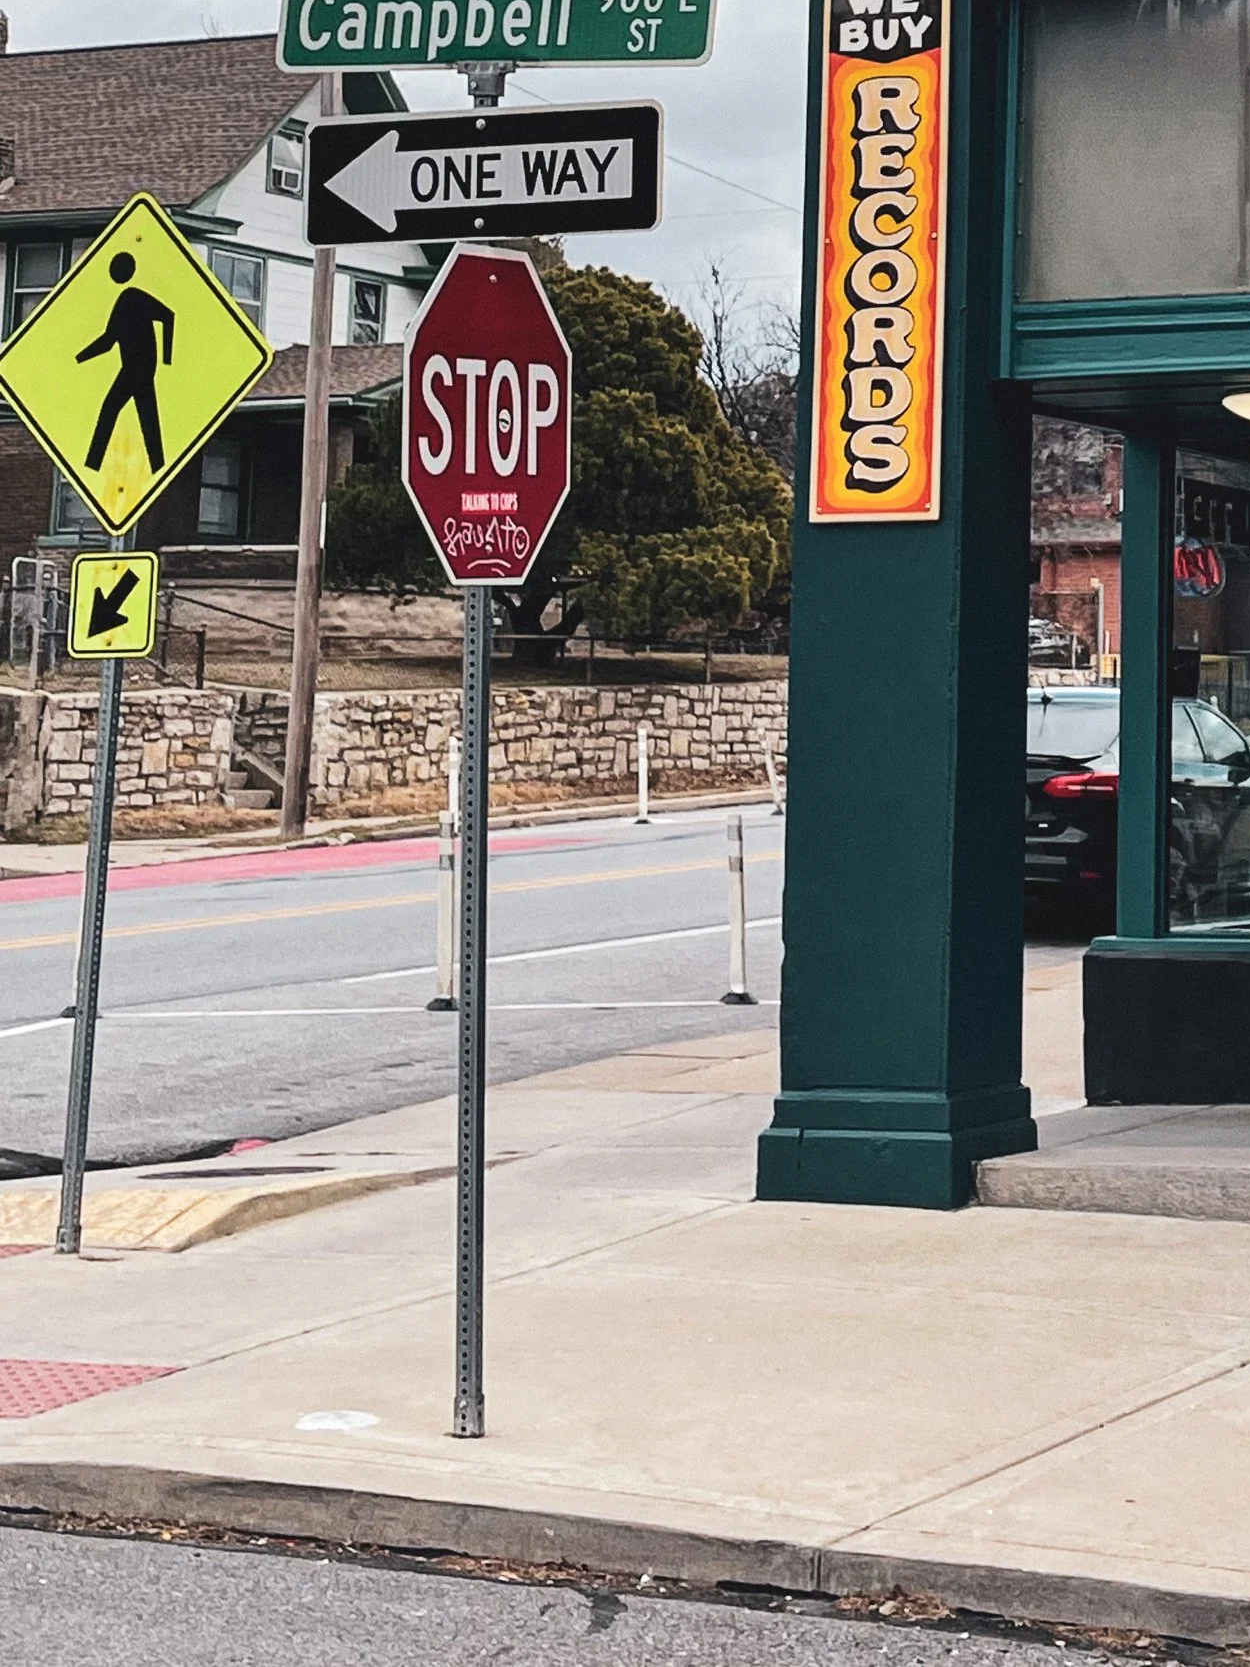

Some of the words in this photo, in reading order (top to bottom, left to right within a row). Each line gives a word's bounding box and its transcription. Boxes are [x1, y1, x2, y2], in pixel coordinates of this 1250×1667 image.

[626, 18, 663, 54] ST
[838, 14, 933, 53] BUY
[410, 152, 502, 203] ONE
[521, 146, 619, 197] WAY
[840, 75, 922, 493] RECORDS
[418, 353, 560, 477] STOP
